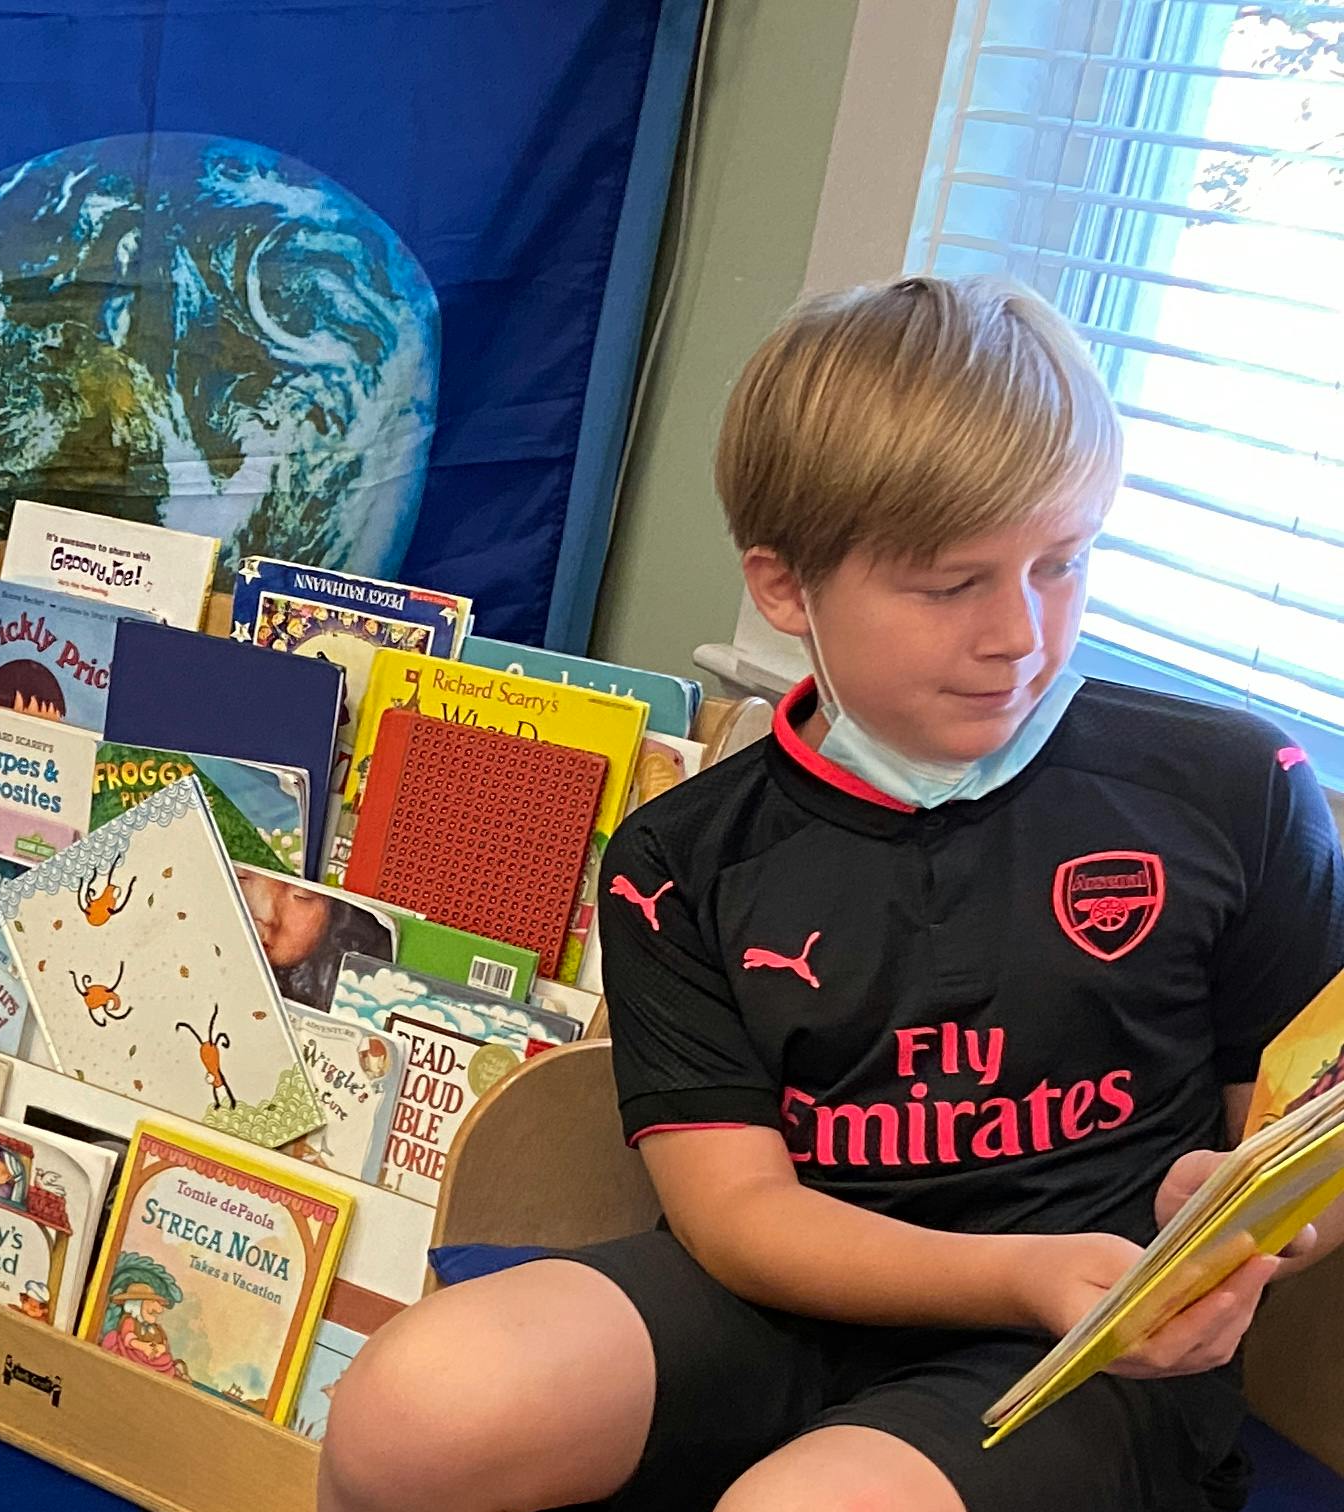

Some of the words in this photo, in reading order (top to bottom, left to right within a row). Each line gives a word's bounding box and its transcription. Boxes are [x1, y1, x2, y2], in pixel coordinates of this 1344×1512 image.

[51, 547, 106, 581] Groovy
[106, 560, 142, 586] Joe!
[98, 544, 107, 552] to
[294, 573, 365, 602] RATHMANN
[366, 587, 405, 611] PEGGY
[56, 640, 112, 689] Pric
[432, 669, 493, 700] Richard
[499, 682, 559, 716] Scarry's
[43, 759, 59, 783] &
[92, 758, 194, 794] FROGGY
[1072, 870, 1148, 892] Arsenal
[302, 1039, 370, 1104] Wiggle's
[893, 1021, 1007, 1085] Fly
[320, 1091, 349, 1121] Cure
[400, 1069, 464, 1114] LOUD
[783, 1069, 1134, 1166] Emirates
[177, 1179, 218, 1208] Tomie
[220, 1198, 275, 1231] dePaola
[141, 1198, 223, 1254] STREGA
[226, 1231, 291, 1282] NONA
[188, 1254, 220, 1281] Takes
[221, 1271, 229, 1283] a
[232, 1273, 282, 1305] Vacation
